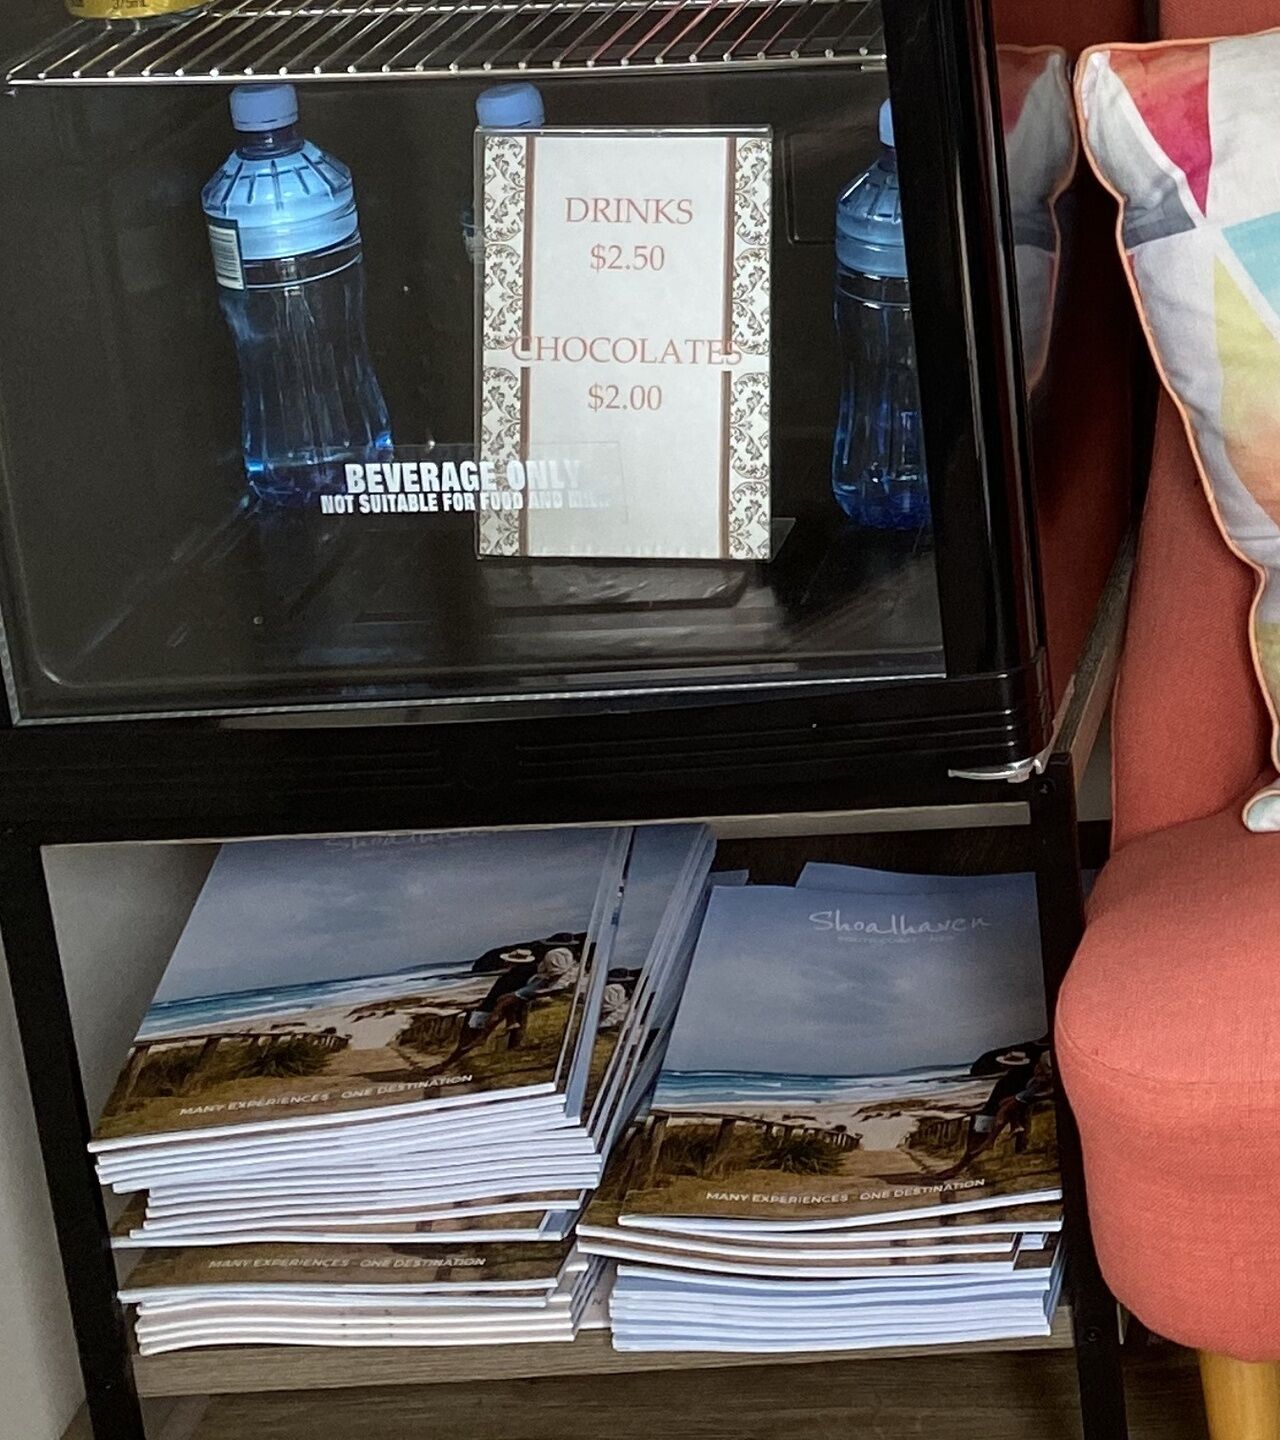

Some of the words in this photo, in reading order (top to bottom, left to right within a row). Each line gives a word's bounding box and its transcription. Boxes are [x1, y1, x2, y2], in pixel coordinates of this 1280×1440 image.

[565, 196, 694, 225] DRINKS
[590, 243, 665, 273] $2.50
[511, 336, 743, 366] CHOCOLATES
[587, 382, 663, 412] $2.00
[344, 460, 497, 493] BEVERAGE
[506, 459, 582, 491] ONLY
[320, 493, 353, 514] NOT
[359, 492, 438, 513] SUITABLE
[442, 492, 475, 511] FOR
[480, 491, 523, 510] FOOD
[808, 909, 993, 935] Shoalhaven
[178, 1103, 224, 1117] MANY
[227, 1092, 330, 1111] EXPERIENCES
[340, 1087, 373, 1100] ONE
[376, 1074, 473, 1096] DESTINATION
[706, 1191, 749, 1202] MANY
[752, 1192, 848, 1205] EXPERIENCES
[859, 1190, 889, 1201] ONE
[893, 1178, 986, 1199] DESTINATION
